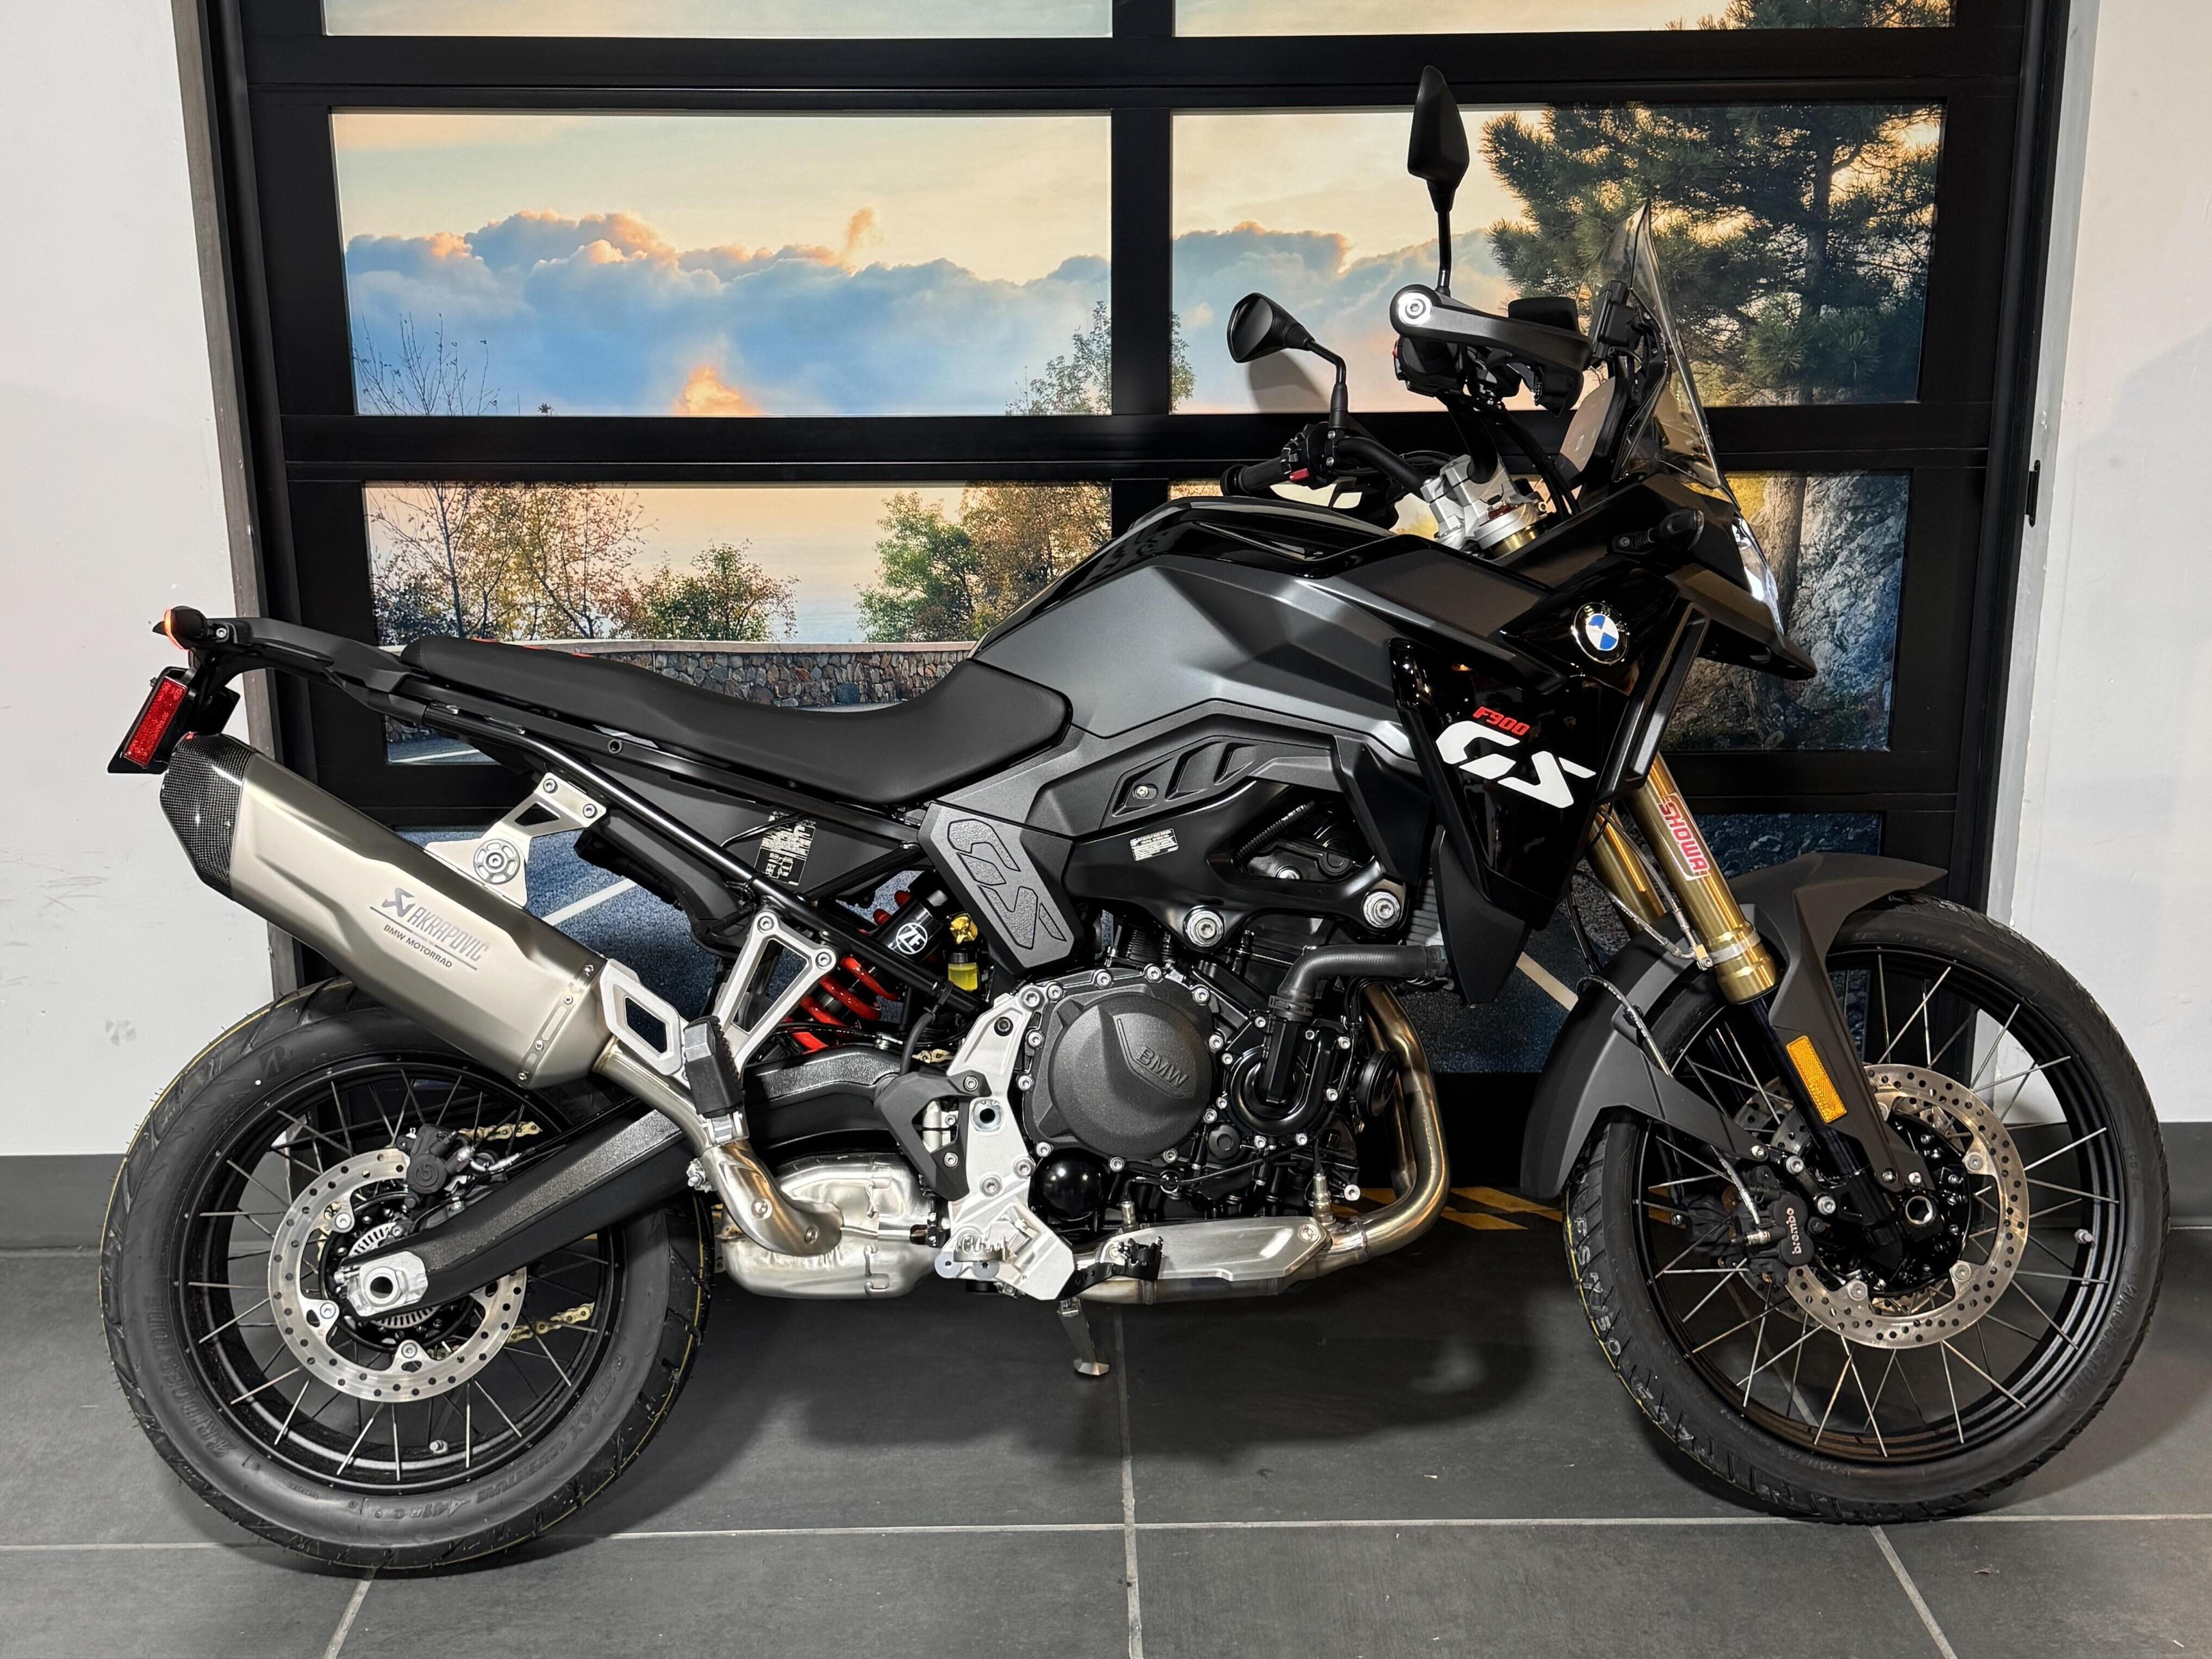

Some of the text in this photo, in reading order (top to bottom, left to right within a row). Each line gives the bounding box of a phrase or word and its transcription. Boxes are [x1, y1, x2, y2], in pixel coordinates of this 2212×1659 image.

[1472, 706, 1530, 736] F900
[1435, 720, 1597, 809] GS
[1658, 801, 1709, 873] SHOWA
[946, 818, 1066, 950] GS
[383, 924, 407, 941] BMW
[406, 937, 452, 969] MOTORRAD
[896, 923, 927, 954] ZF
[1136, 1045, 1189, 1089] BMW
[1786, 1207, 1802, 1255] brembo
